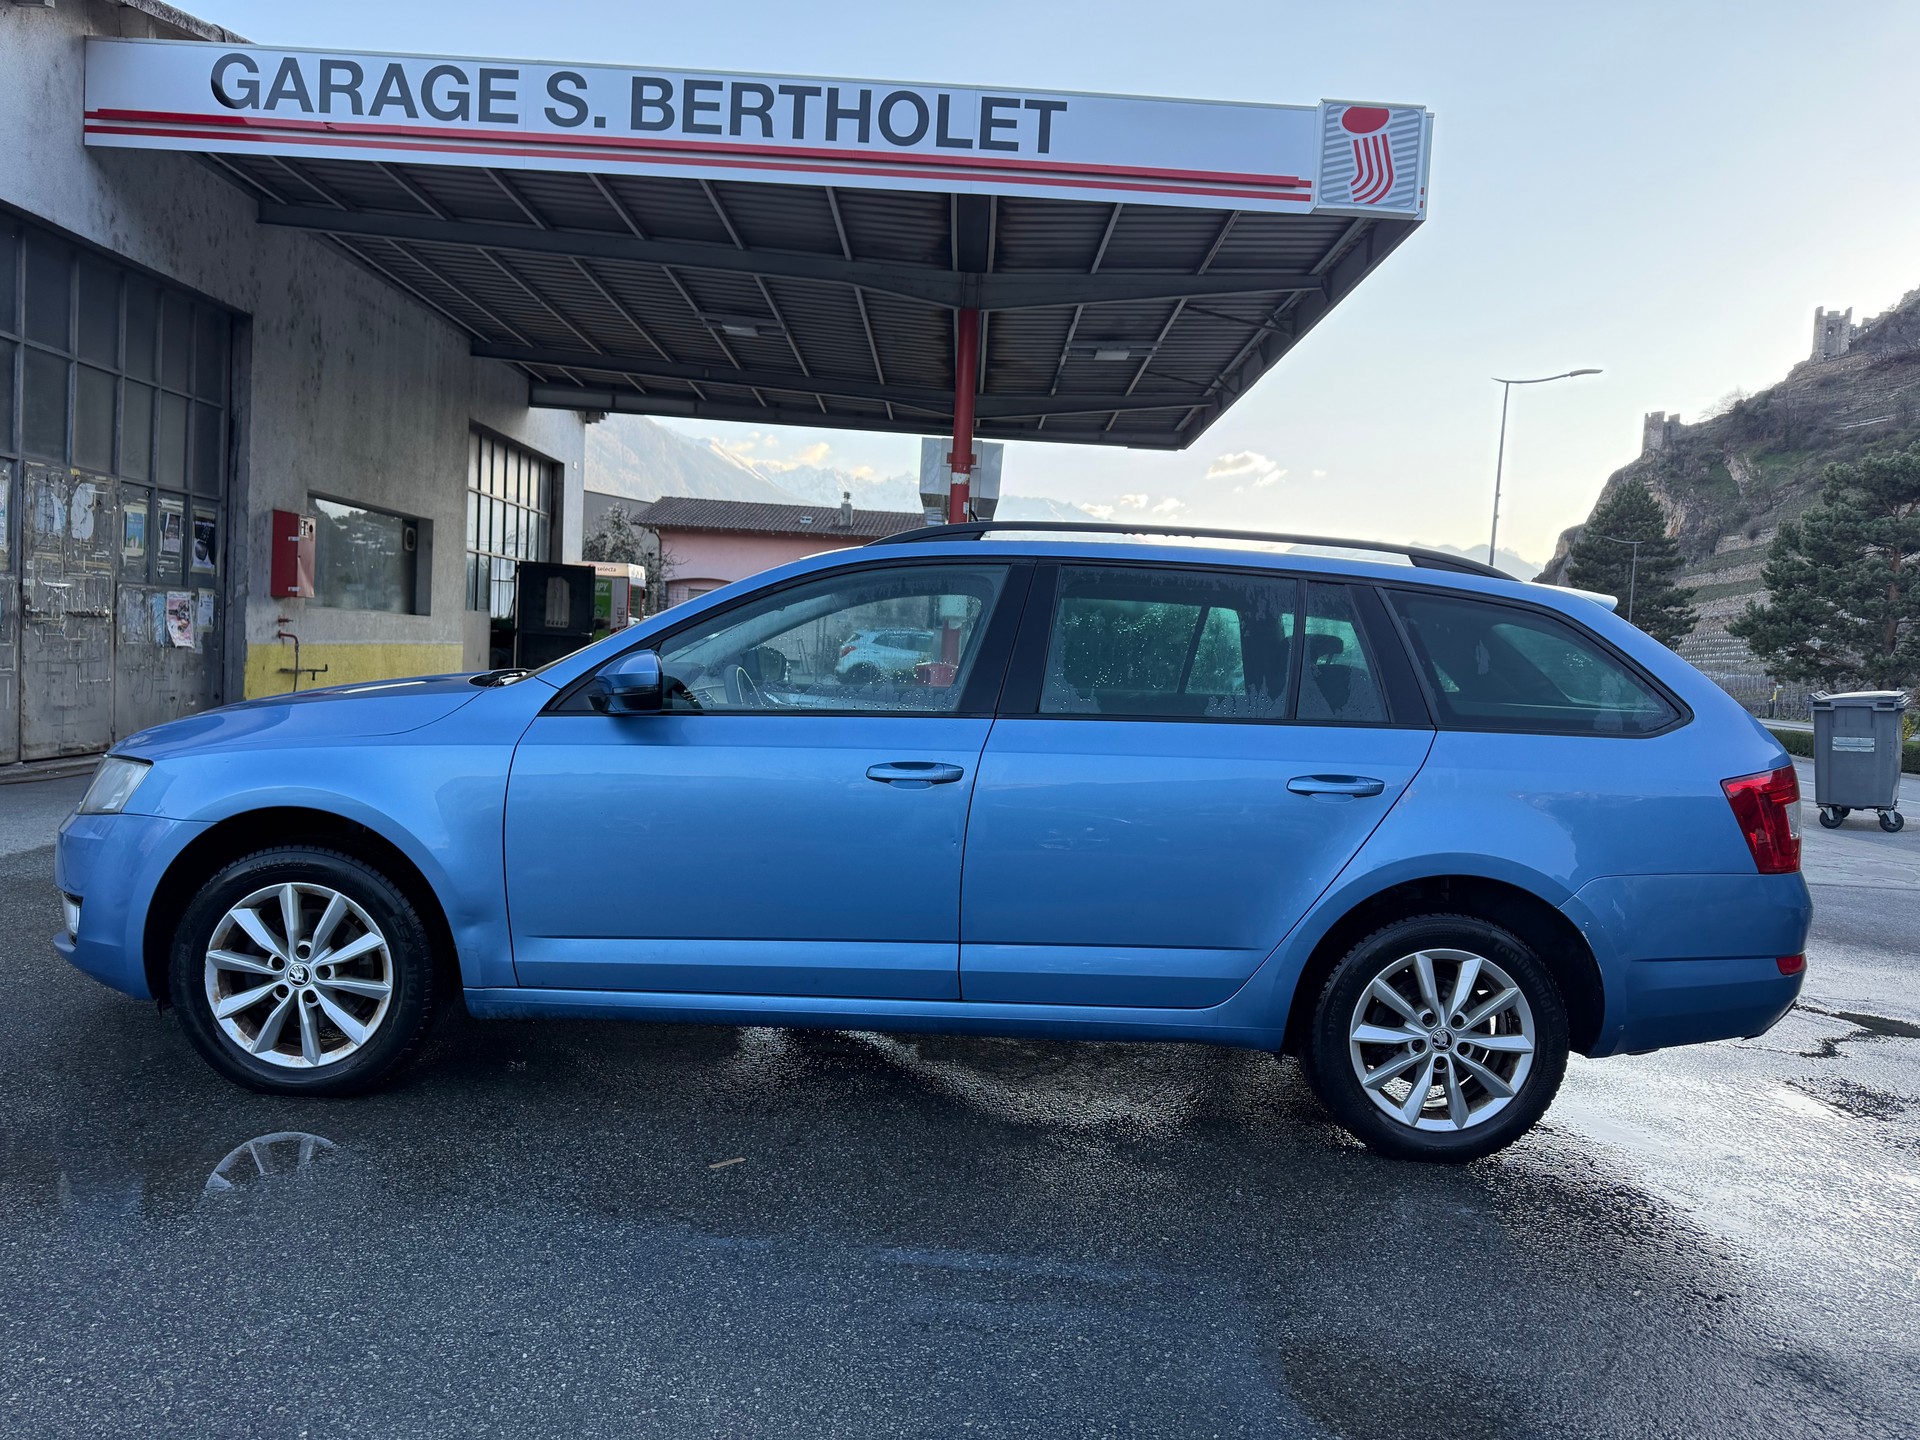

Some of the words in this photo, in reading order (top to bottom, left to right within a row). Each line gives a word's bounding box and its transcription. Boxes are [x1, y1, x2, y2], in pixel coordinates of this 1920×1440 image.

[210, 53, 519, 124] GARAGE
[543, 71, 607, 129] S.
[630, 76, 1068, 154] BERTHOLET
[1495, 943, 1556, 1013] Continental
